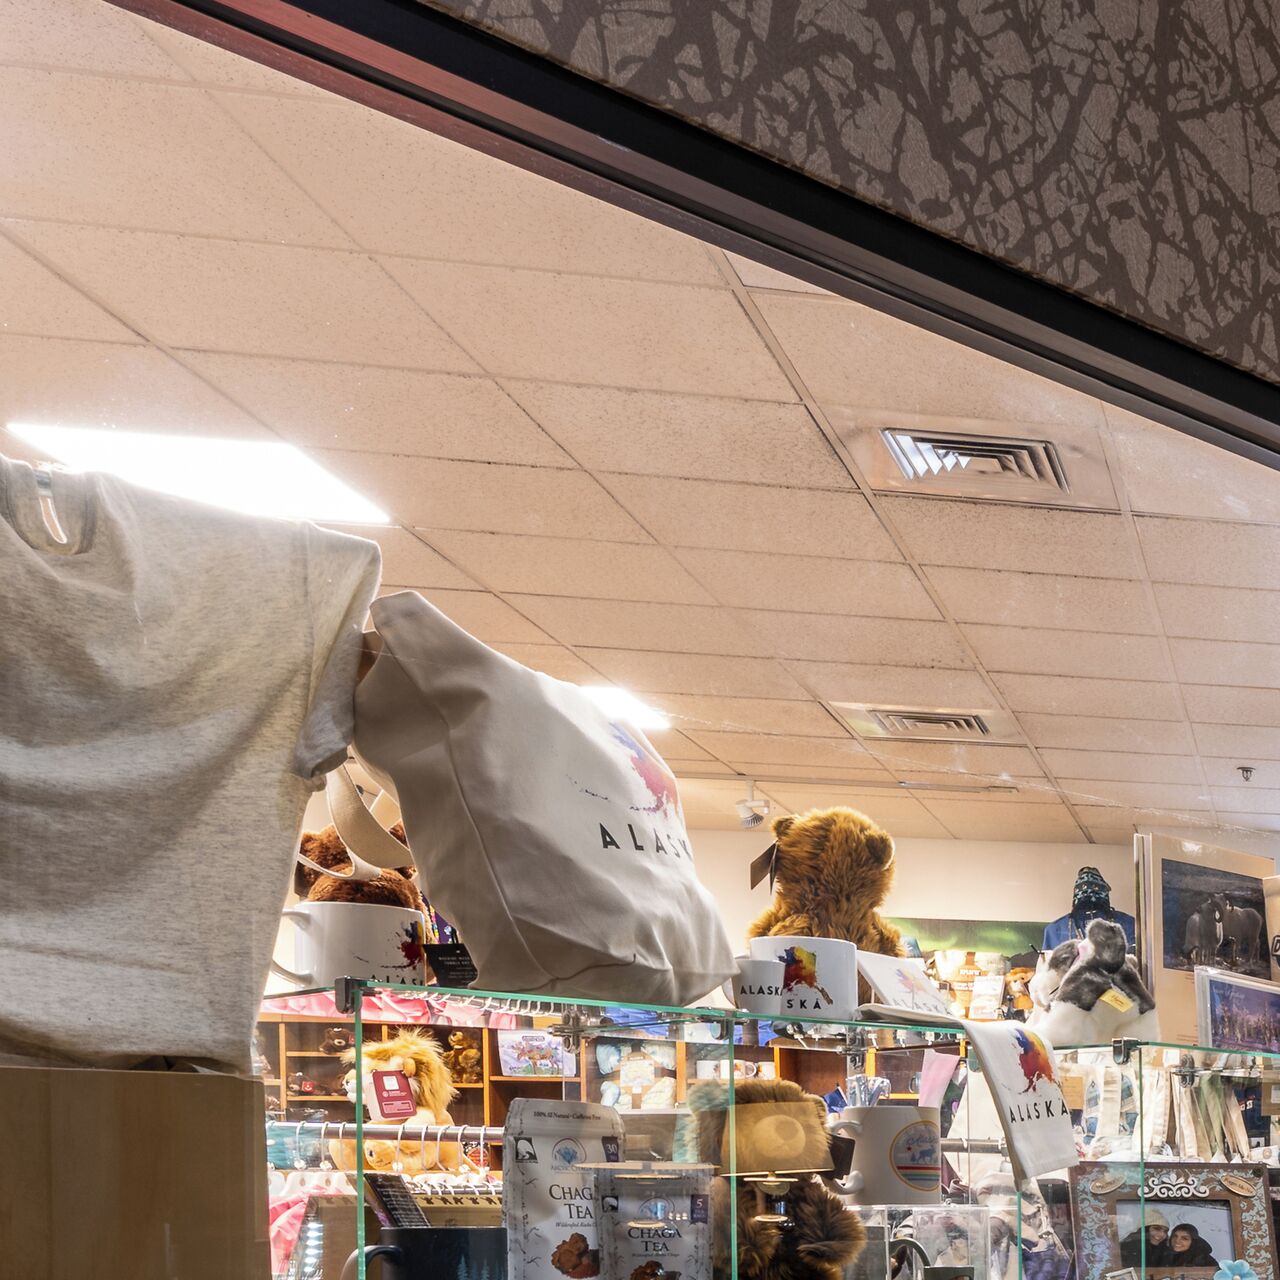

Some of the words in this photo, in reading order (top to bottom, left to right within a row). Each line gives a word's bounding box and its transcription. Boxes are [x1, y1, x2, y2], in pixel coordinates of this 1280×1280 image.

[1010, 1099, 1069, 1124] ALASKA
[605, 1143, 617, 1154] 30
[564, 1203, 594, 1219] TEA
[628, 1228, 682, 1239] CHAGA
[641, 1241, 670, 1252] TEA
